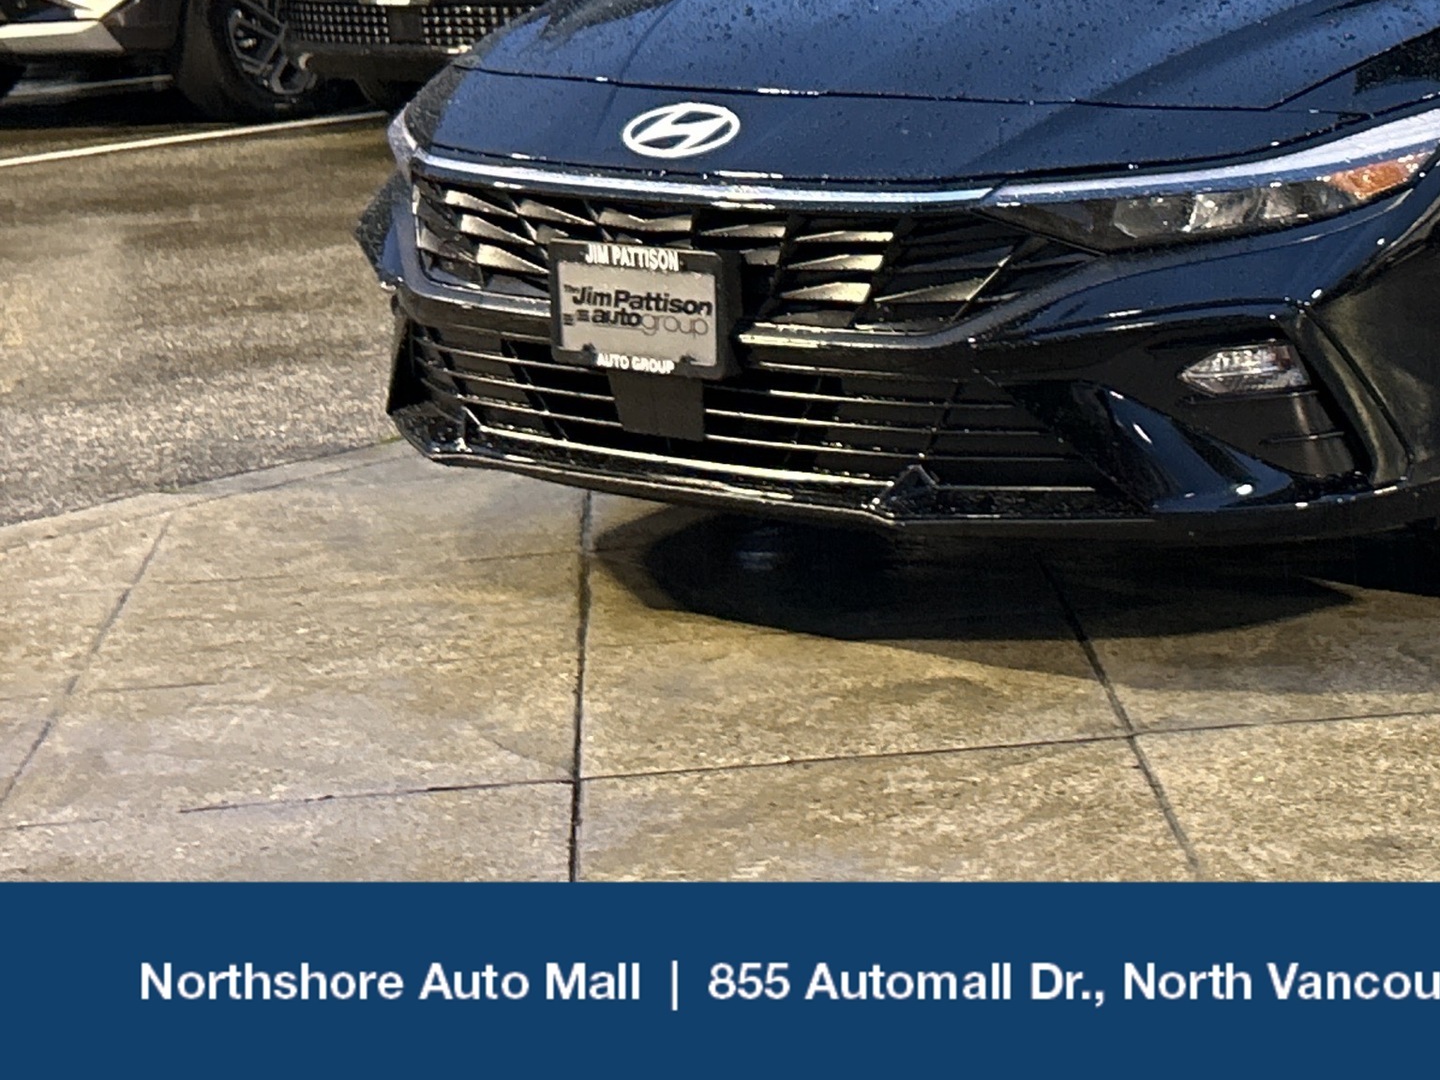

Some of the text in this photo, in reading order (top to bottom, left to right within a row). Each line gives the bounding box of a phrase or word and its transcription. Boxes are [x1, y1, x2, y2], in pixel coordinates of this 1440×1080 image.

[585, 243, 680, 271] JIM PATTISON
[597, 352, 675, 374] AUTO GROUP
